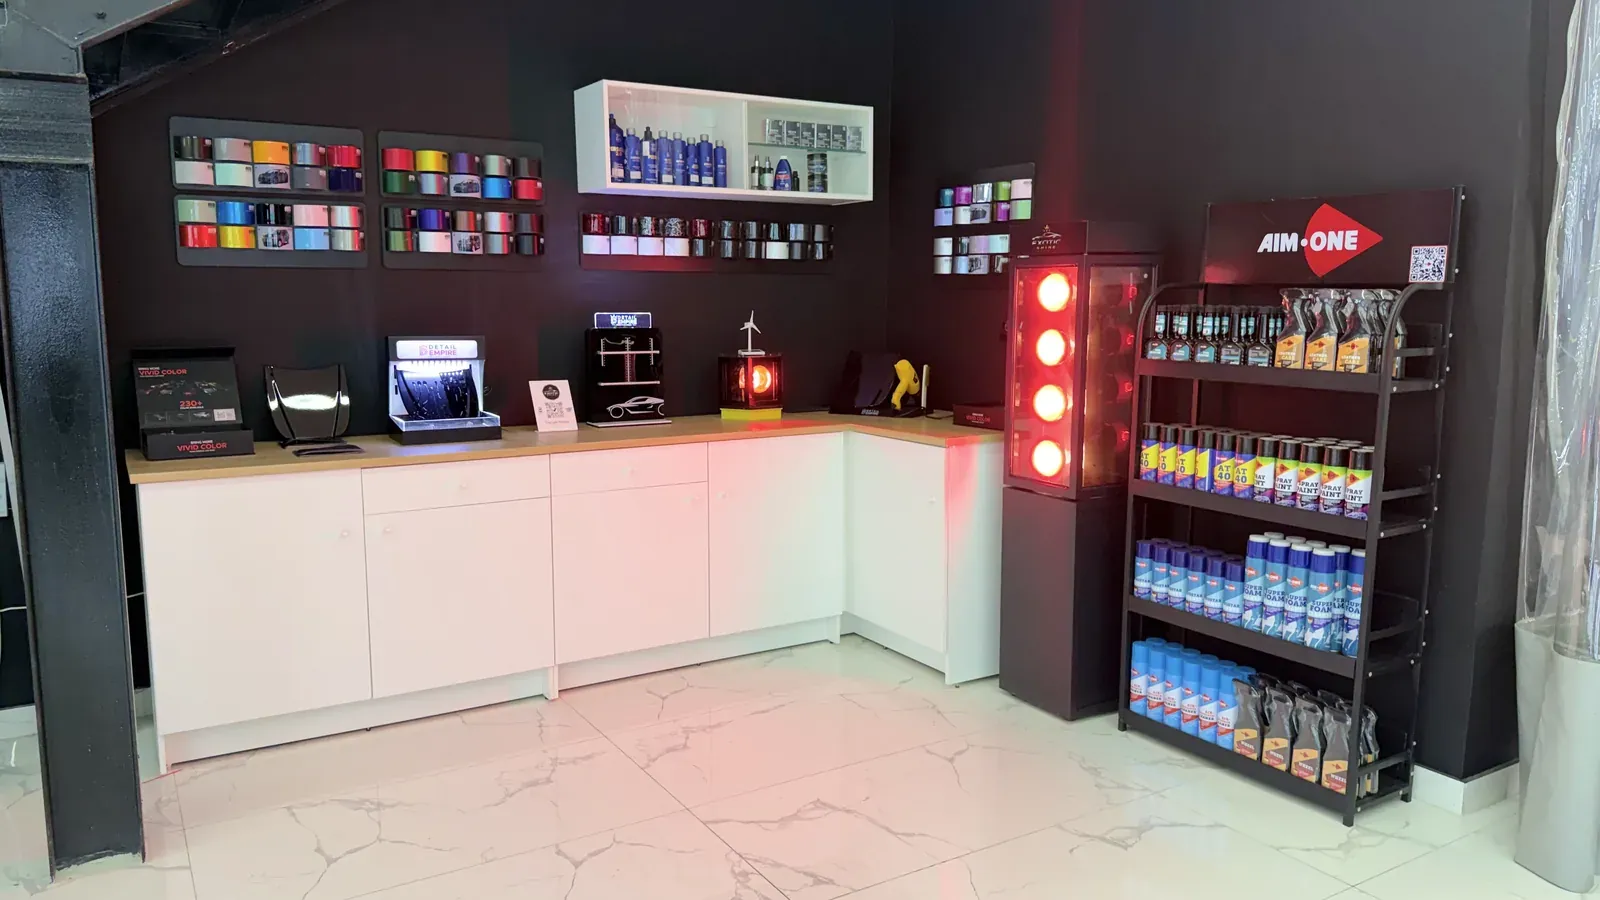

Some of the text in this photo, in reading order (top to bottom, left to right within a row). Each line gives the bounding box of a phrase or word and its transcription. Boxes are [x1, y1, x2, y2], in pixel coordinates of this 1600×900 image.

[200, 442, 227, 450] COLOR
[1218, 464, 1231, 472] AT
[1235, 467, 1247, 475] AT
[1217, 472, 1231, 480] 40
[1235, 475, 1247, 483] 40
[1321, 490, 1342, 498] AINT
[1346, 488, 1363, 496] PRAY
[1244, 588, 1262, 597] OAM
[1346, 600, 1360, 608] SUP
[1346, 606, 1360, 614] FOA
